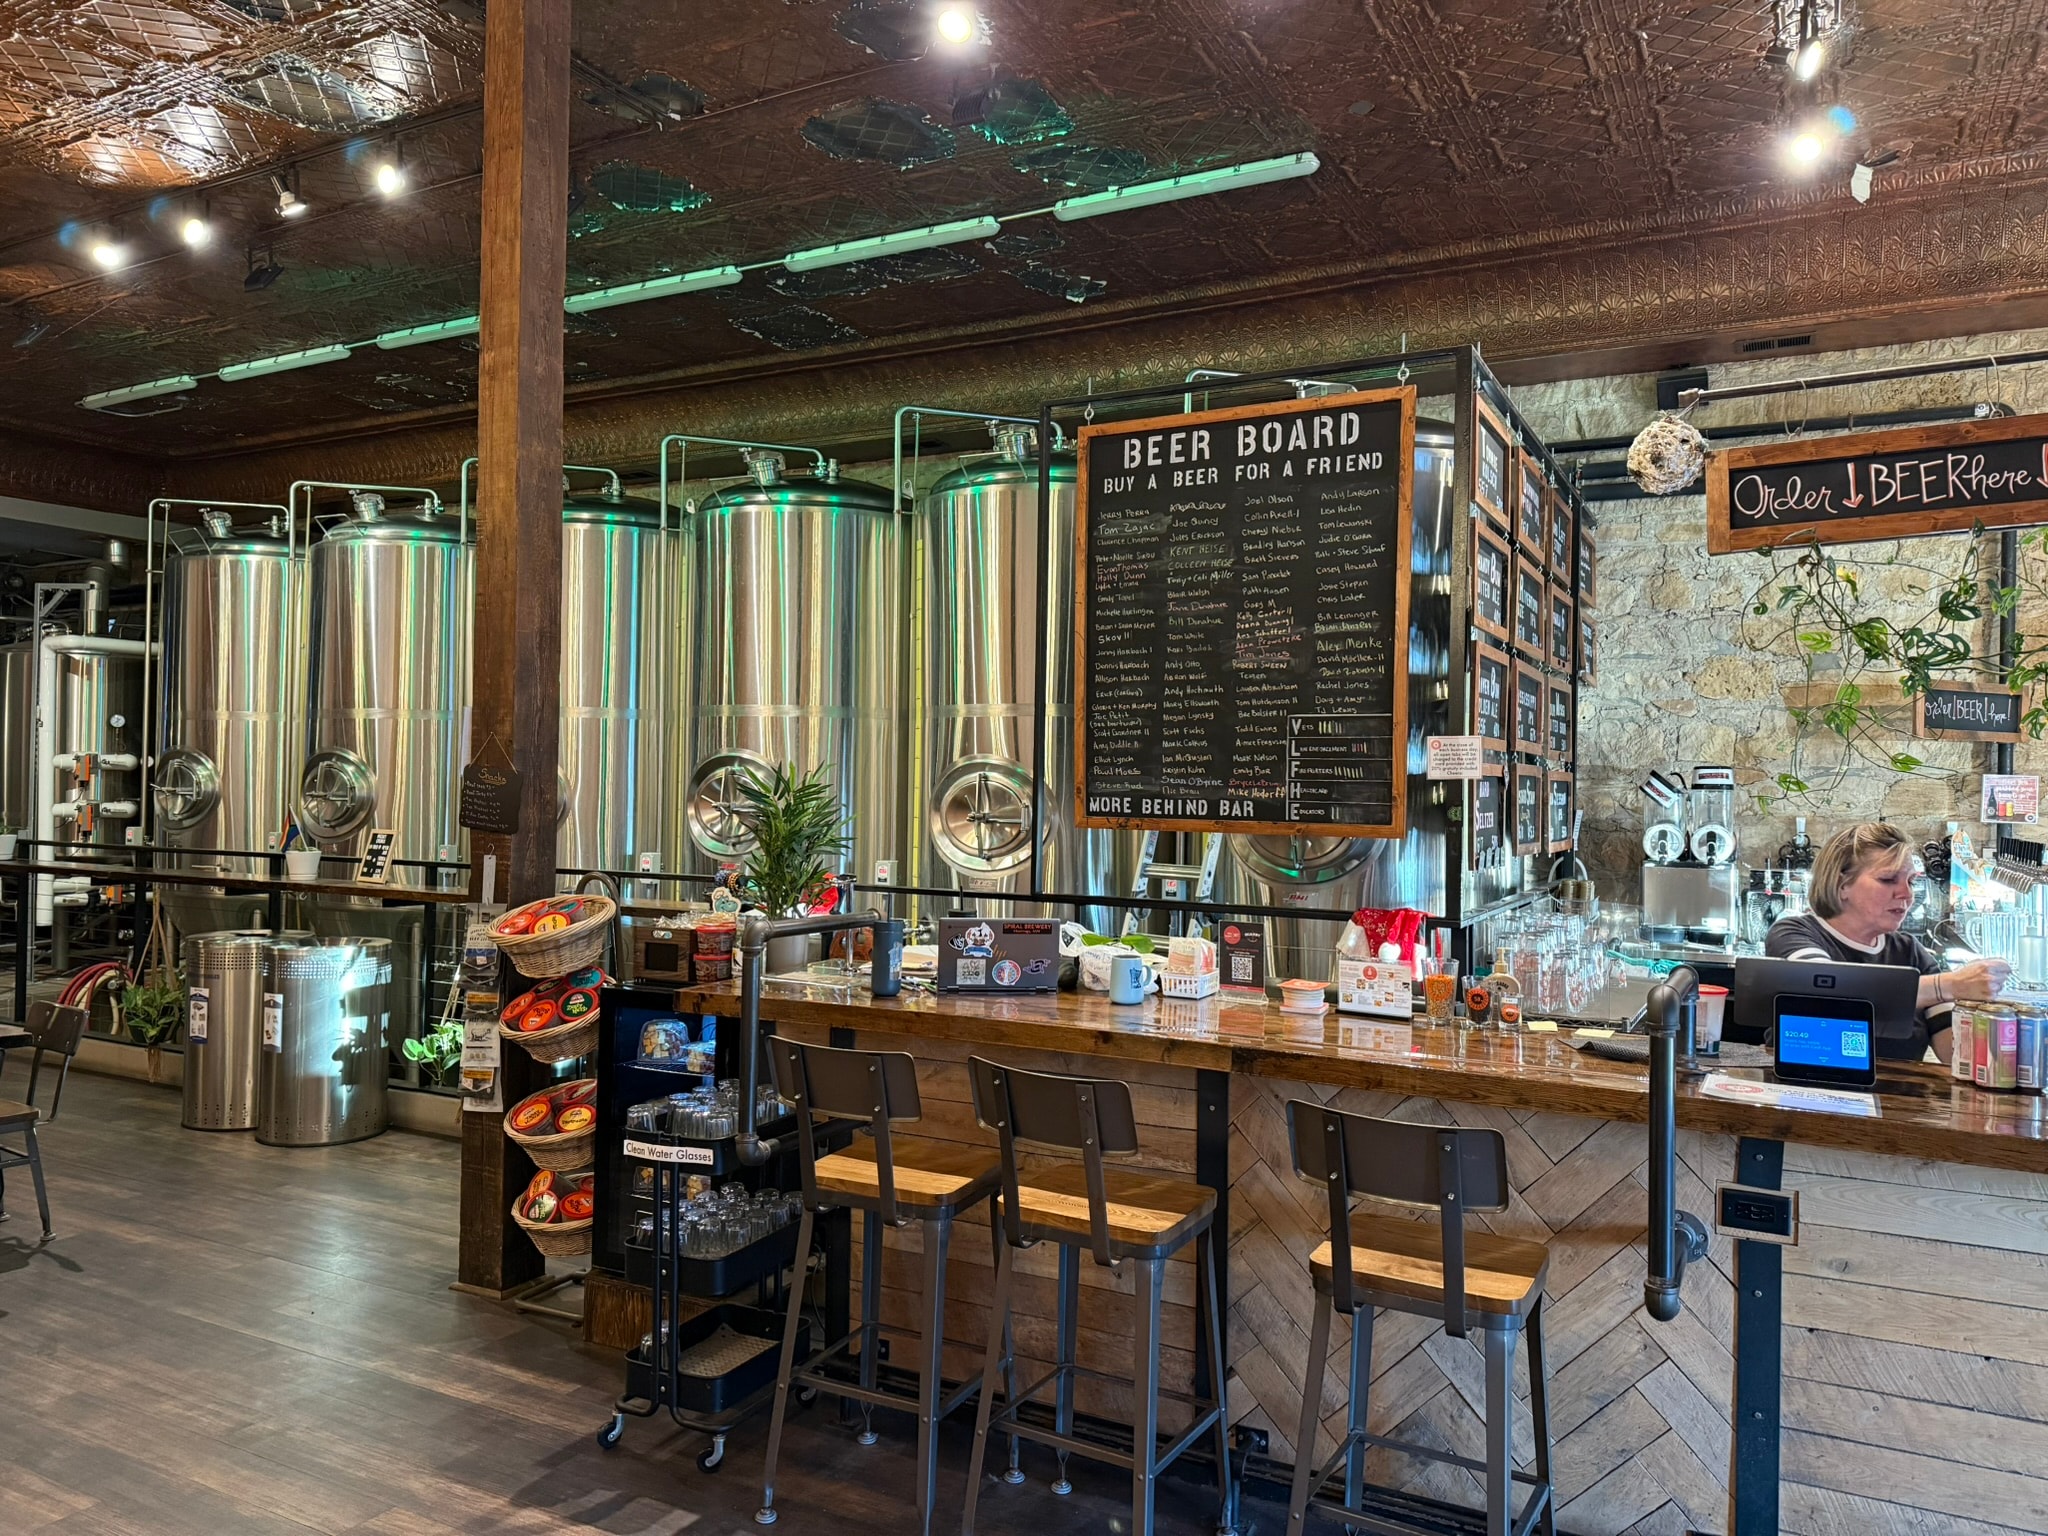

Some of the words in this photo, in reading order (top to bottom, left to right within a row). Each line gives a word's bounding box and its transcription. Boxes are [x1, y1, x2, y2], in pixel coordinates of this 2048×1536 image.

[1123, 429, 1211, 470] BEER
[1236, 411, 1360, 457] BOARD
[1103, 475, 1135, 495] BUY
[1147, 474, 1158, 490] A
[1173, 466, 1219, 488] BEER
[1234, 461, 1271, 483] FOR
[1282, 459, 1294, 478] A
[1306, 451, 1384, 476] FRIEND
[1734, 474, 1839, 520] Order
[1868, 452, 1972, 507] BEER
[1963, 453, 2033, 500] here
[1098, 523, 1119, 536] Tom
[1117, 561, 1149, 572] Thomas
[1956, 699, 1985, 725] BEER
[478, 767, 507, 785] Snacks
[1227, 787, 1249, 798] Mike
[1089, 796, 1132, 814] MORE
[1141, 797, 1209, 816] BEHIND
[1219, 799, 1254, 818] BAR
[625, 1141, 646, 1156] Clean
[647, 1144, 673, 1159] Water
[676, 1149, 712, 1163] Glasses
